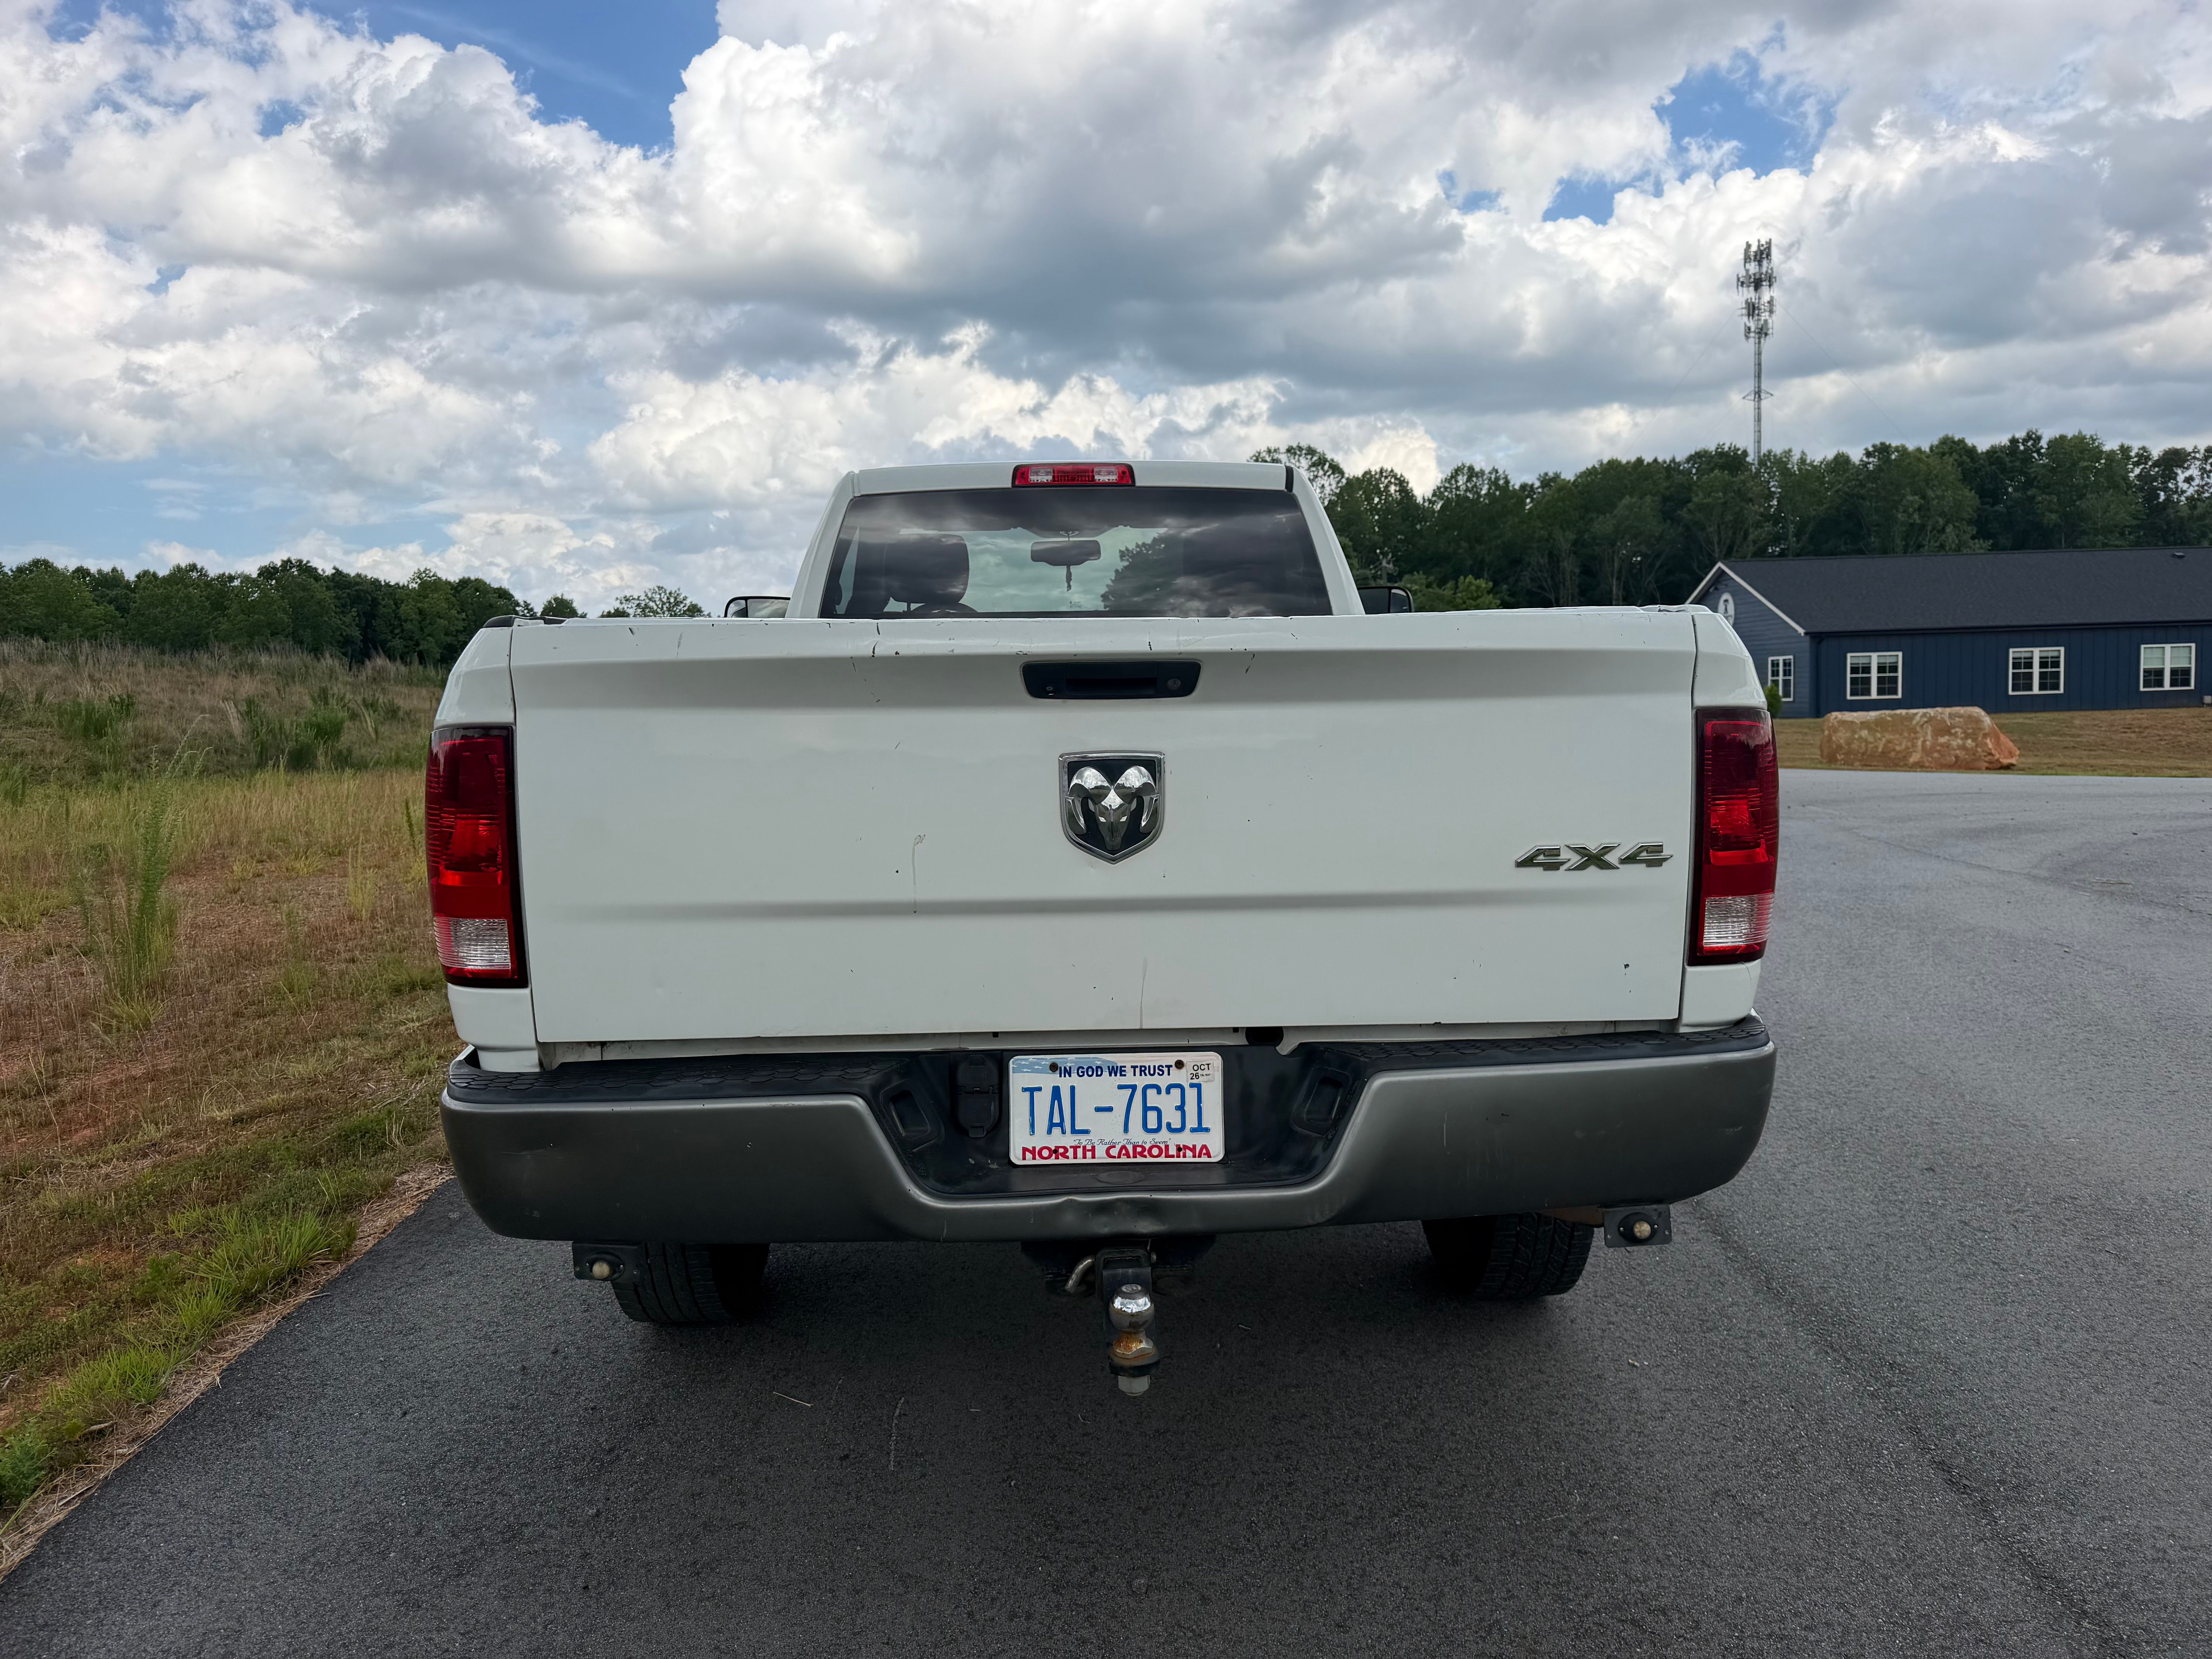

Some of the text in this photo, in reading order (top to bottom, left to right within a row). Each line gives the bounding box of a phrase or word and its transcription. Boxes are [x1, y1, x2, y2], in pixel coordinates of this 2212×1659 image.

[1515, 842, 1673, 871] 4X4
[1059, 1065, 1173, 1077] IN GOD WE TRUST
[1192, 1063, 1211, 1072] OCT
[1022, 1083, 1211, 1135] TAL-7631
[1022, 1144, 1212, 1161] NORTH CAROLINA
